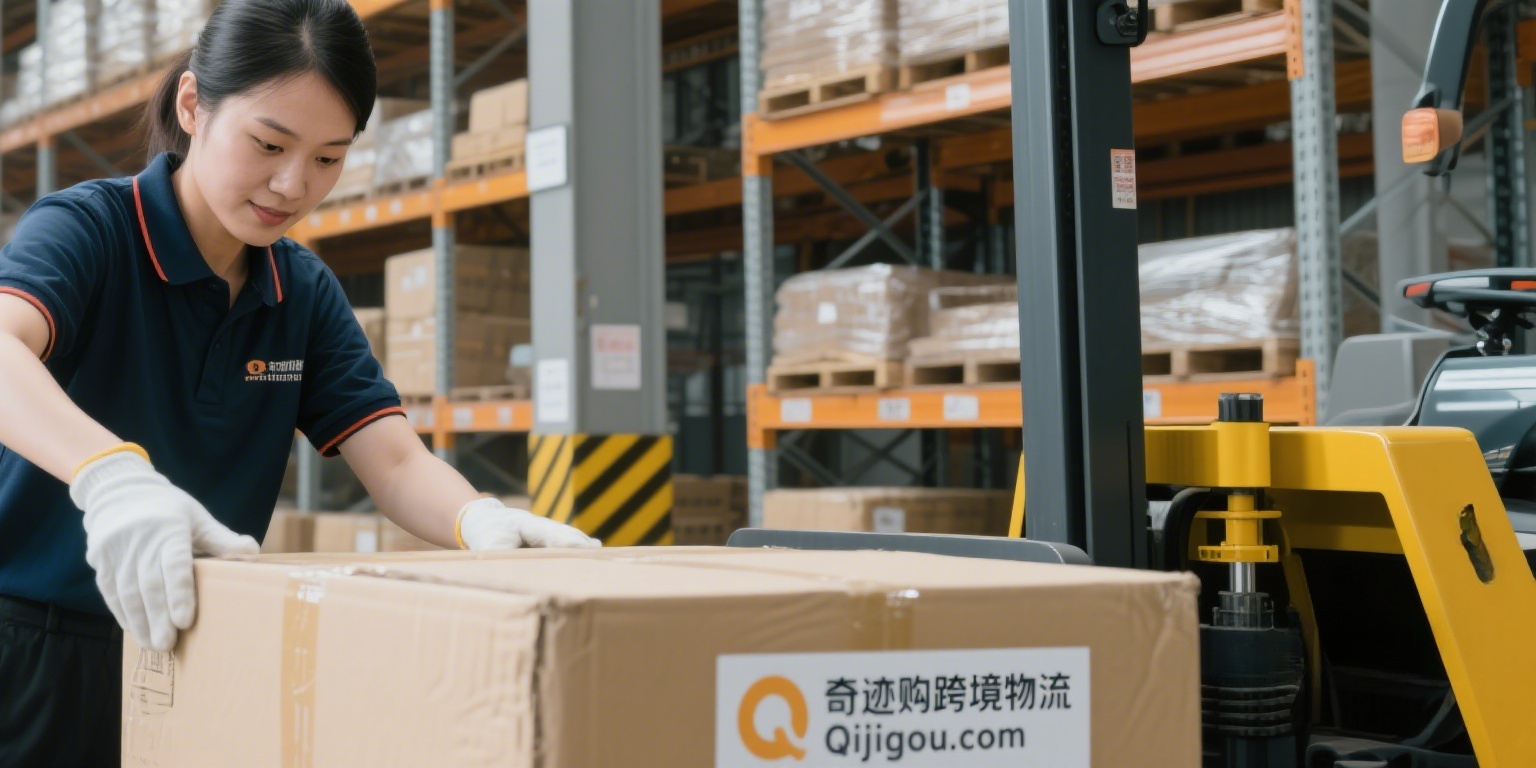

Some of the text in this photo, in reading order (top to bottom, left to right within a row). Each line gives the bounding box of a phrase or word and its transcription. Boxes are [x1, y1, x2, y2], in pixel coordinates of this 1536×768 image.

[824, 672, 1071, 715] 奇迹购跨境物流
[825, 723, 1025, 762] Qijigou.com
